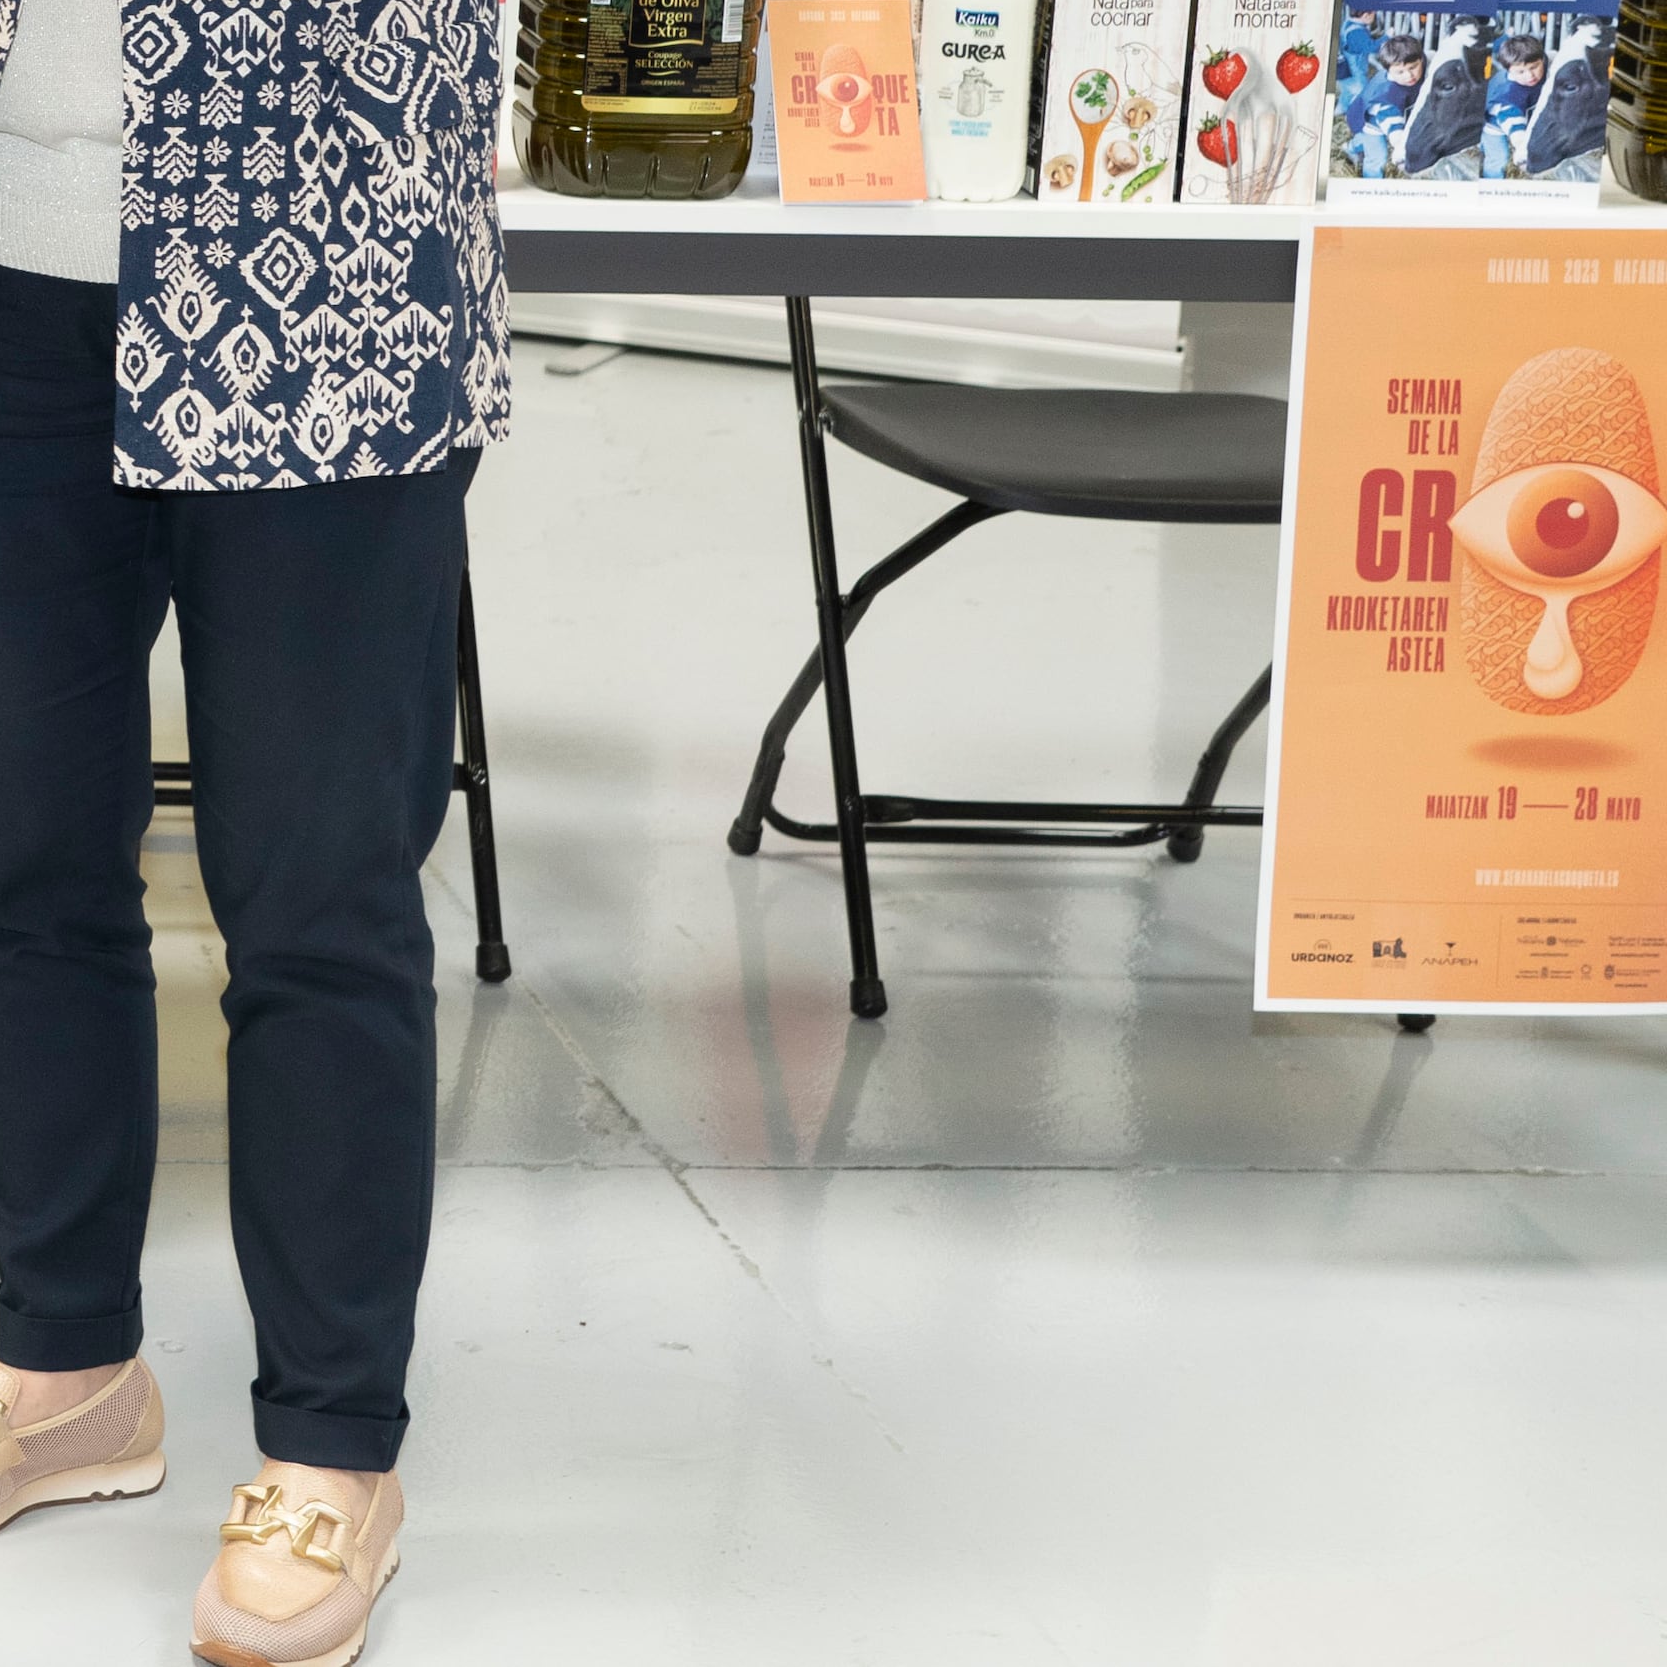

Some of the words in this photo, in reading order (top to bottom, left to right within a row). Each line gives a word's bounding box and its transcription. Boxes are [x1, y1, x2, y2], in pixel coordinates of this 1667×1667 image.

[644, 9, 693, 26] Virgen
[1090, 10, 1154, 27] cocinar
[1130, 0, 1154, 11] para
[1273, 0, 1296, 11] para
[647, 24, 688, 38] Extra
[958, 11, 997, 27] Kaiku
[1233, 11, 1298, 29] montar
[634, 57, 694, 69] SELECCIÓN
[791, 74, 819, 104] CR
[871, 74, 910, 104] QUE
[874, 106, 900, 137] TA
[1487, 258, 1550, 284] NAVARRA
[1563, 258, 1599, 284] 2023
[1387, 378, 1462, 415] SEMANA
[1407, 419, 1431, 455] DE
[1437, 419, 1459, 456] LA
[1355, 467, 1457, 583] CR
[1326, 595, 1449, 632] KROKETAREN
[1386, 636, 1445, 673] ASTEA
[1425, 795, 1489, 820] MAIATZAK
[1497, 785, 1518, 820] 19
[1573, 786, 1599, 821] 28
[1605, 796, 1642, 821] MAYO
